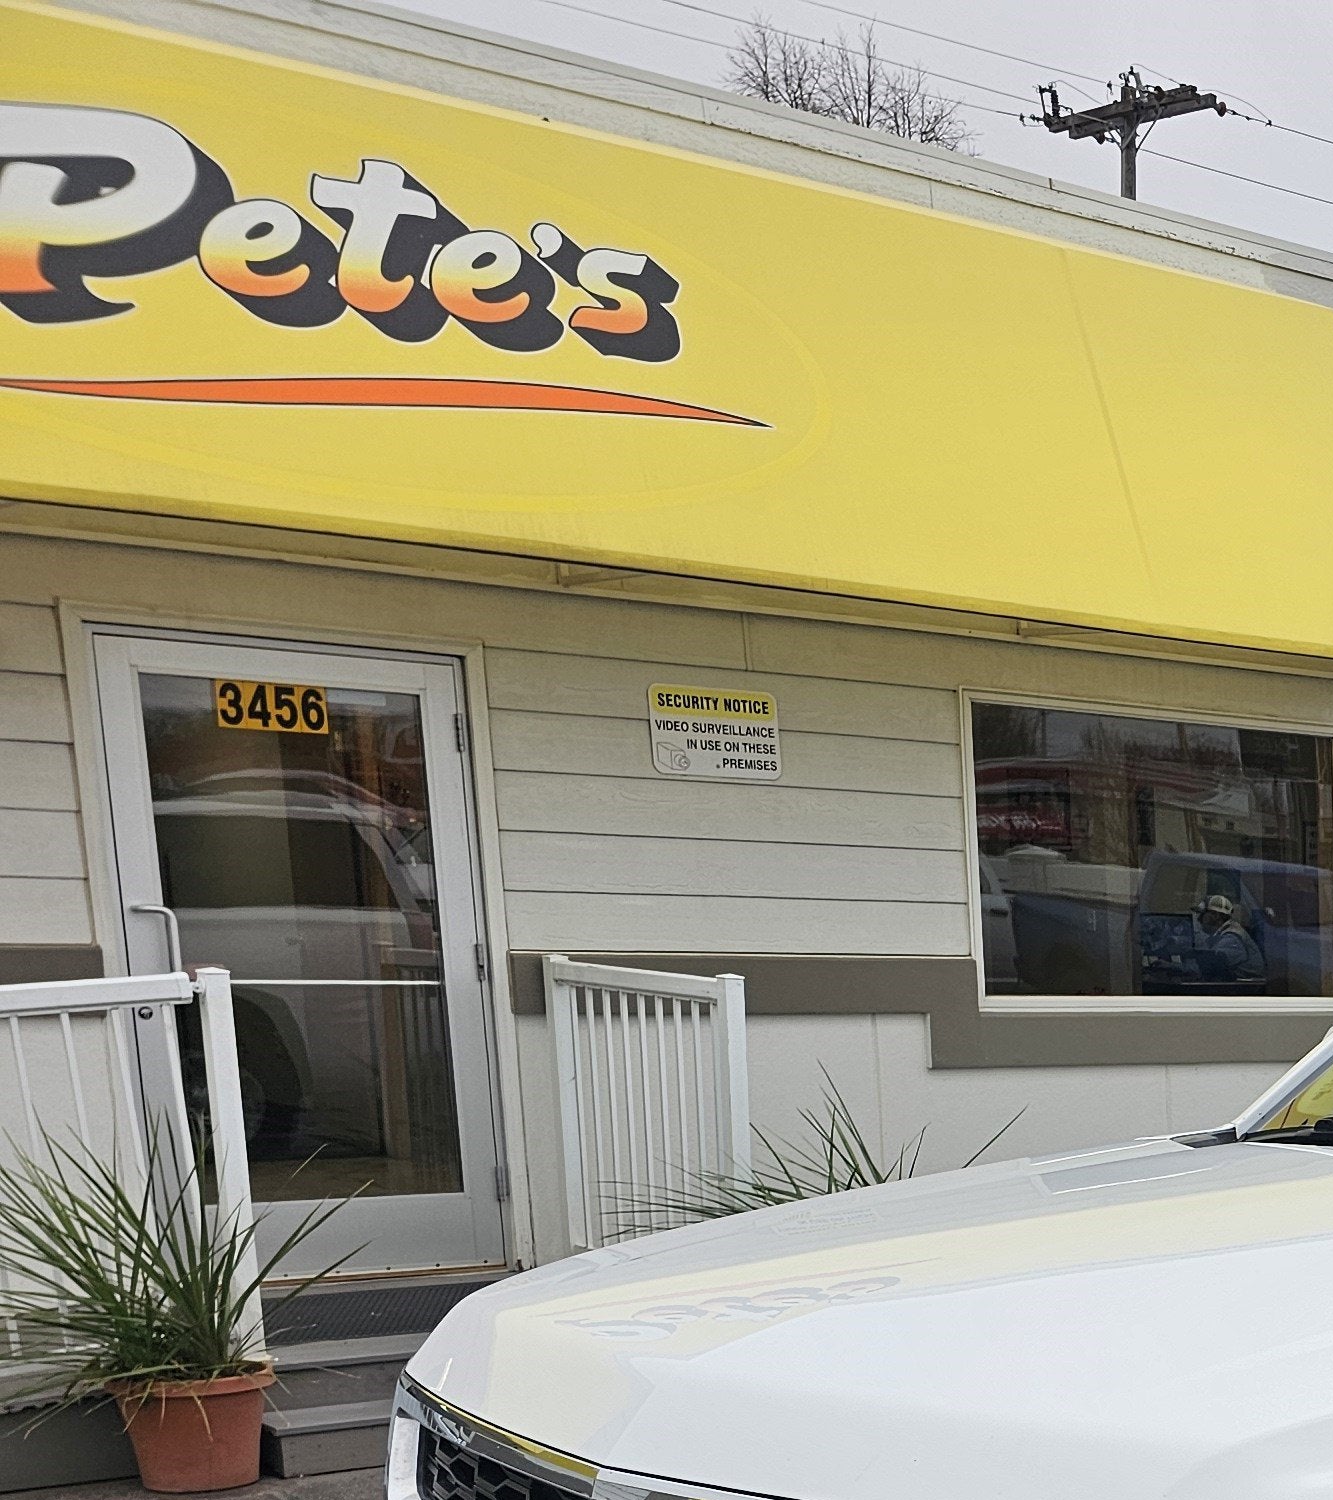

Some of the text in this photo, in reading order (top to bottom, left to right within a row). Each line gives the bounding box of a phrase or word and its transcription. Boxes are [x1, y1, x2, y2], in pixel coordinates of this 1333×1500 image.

[0, 103, 672, 358] Pete's
[219, 682, 325, 731] 3456
[657, 692, 770, 715] SECURITY NOTICE
[655, 719, 775, 738] VIDEO SURVEILLANCE
[686, 738, 777, 755] IN USE ON THESE
[722, 758, 778, 771] PREMISES
